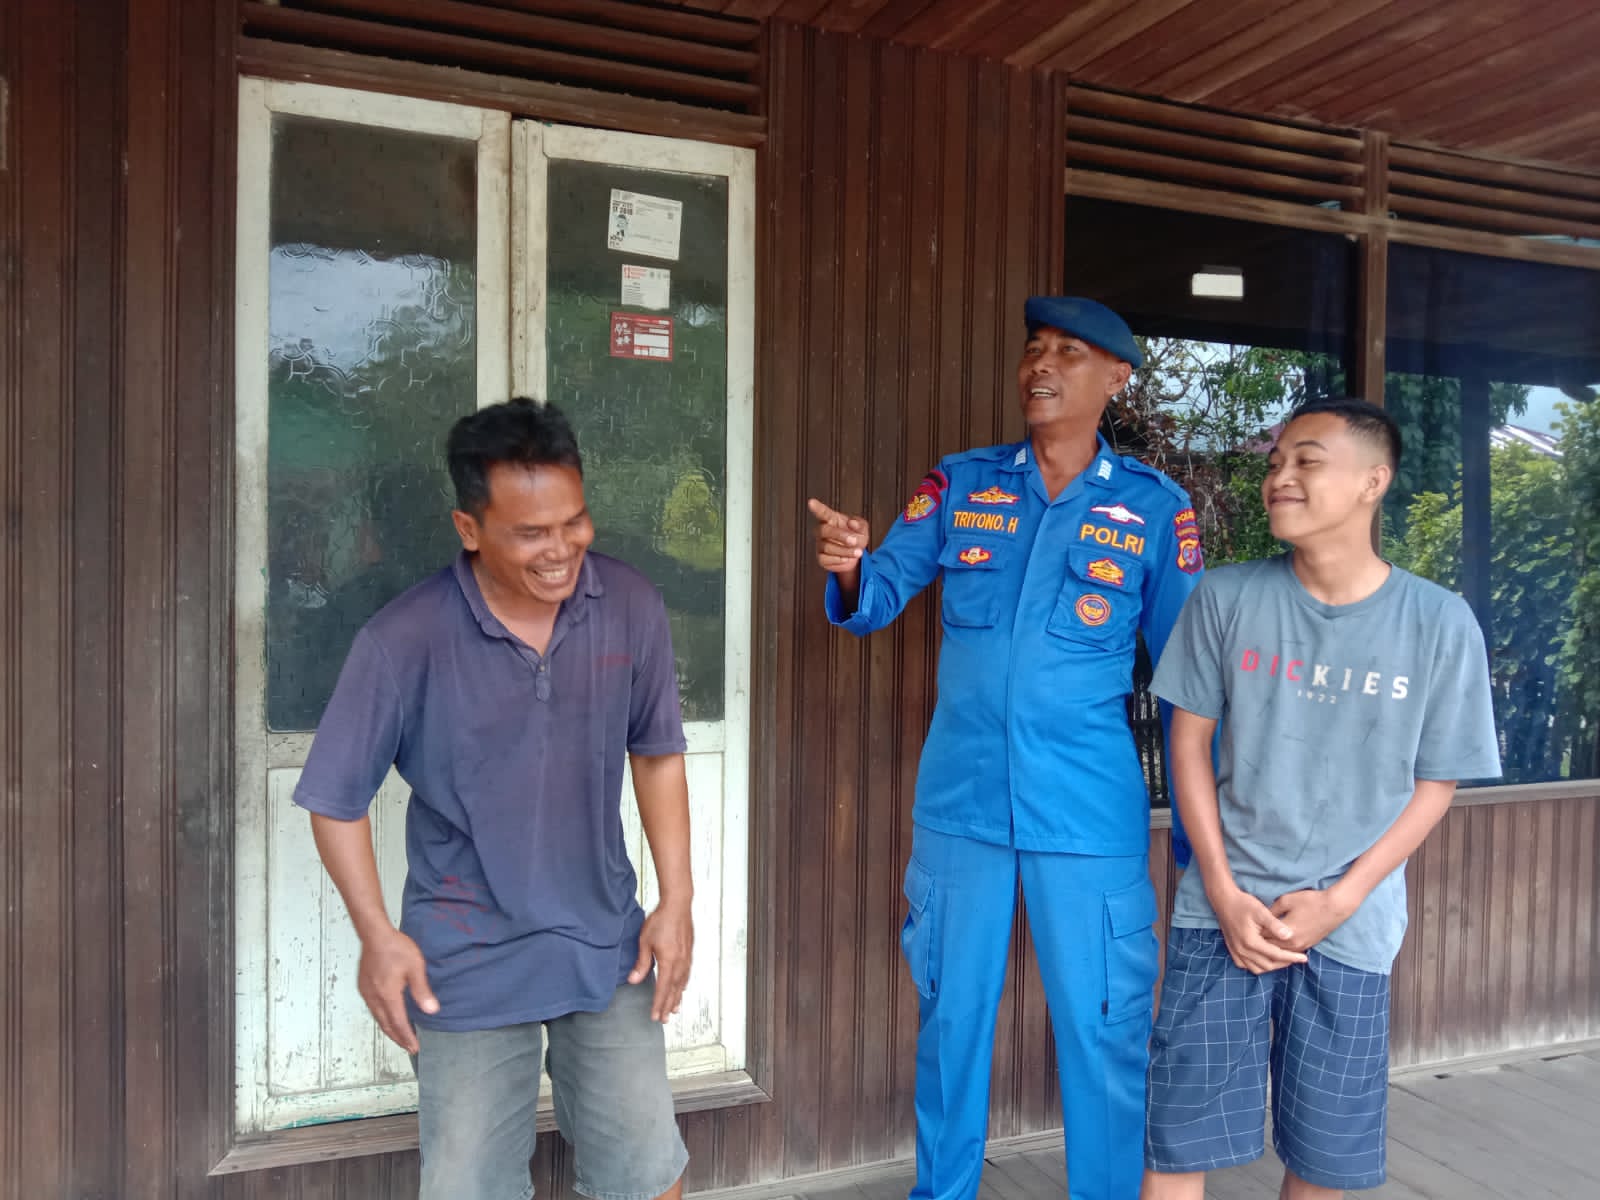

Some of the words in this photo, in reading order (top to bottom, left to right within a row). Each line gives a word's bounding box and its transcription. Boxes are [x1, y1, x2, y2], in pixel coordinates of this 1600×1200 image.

[953, 511, 1005, 531] TRIYONO.
[1007, 516, 1019, 534] H
[1080, 523, 1145, 555] POLRI
[1239, 649, 1409, 700] DICKIES
